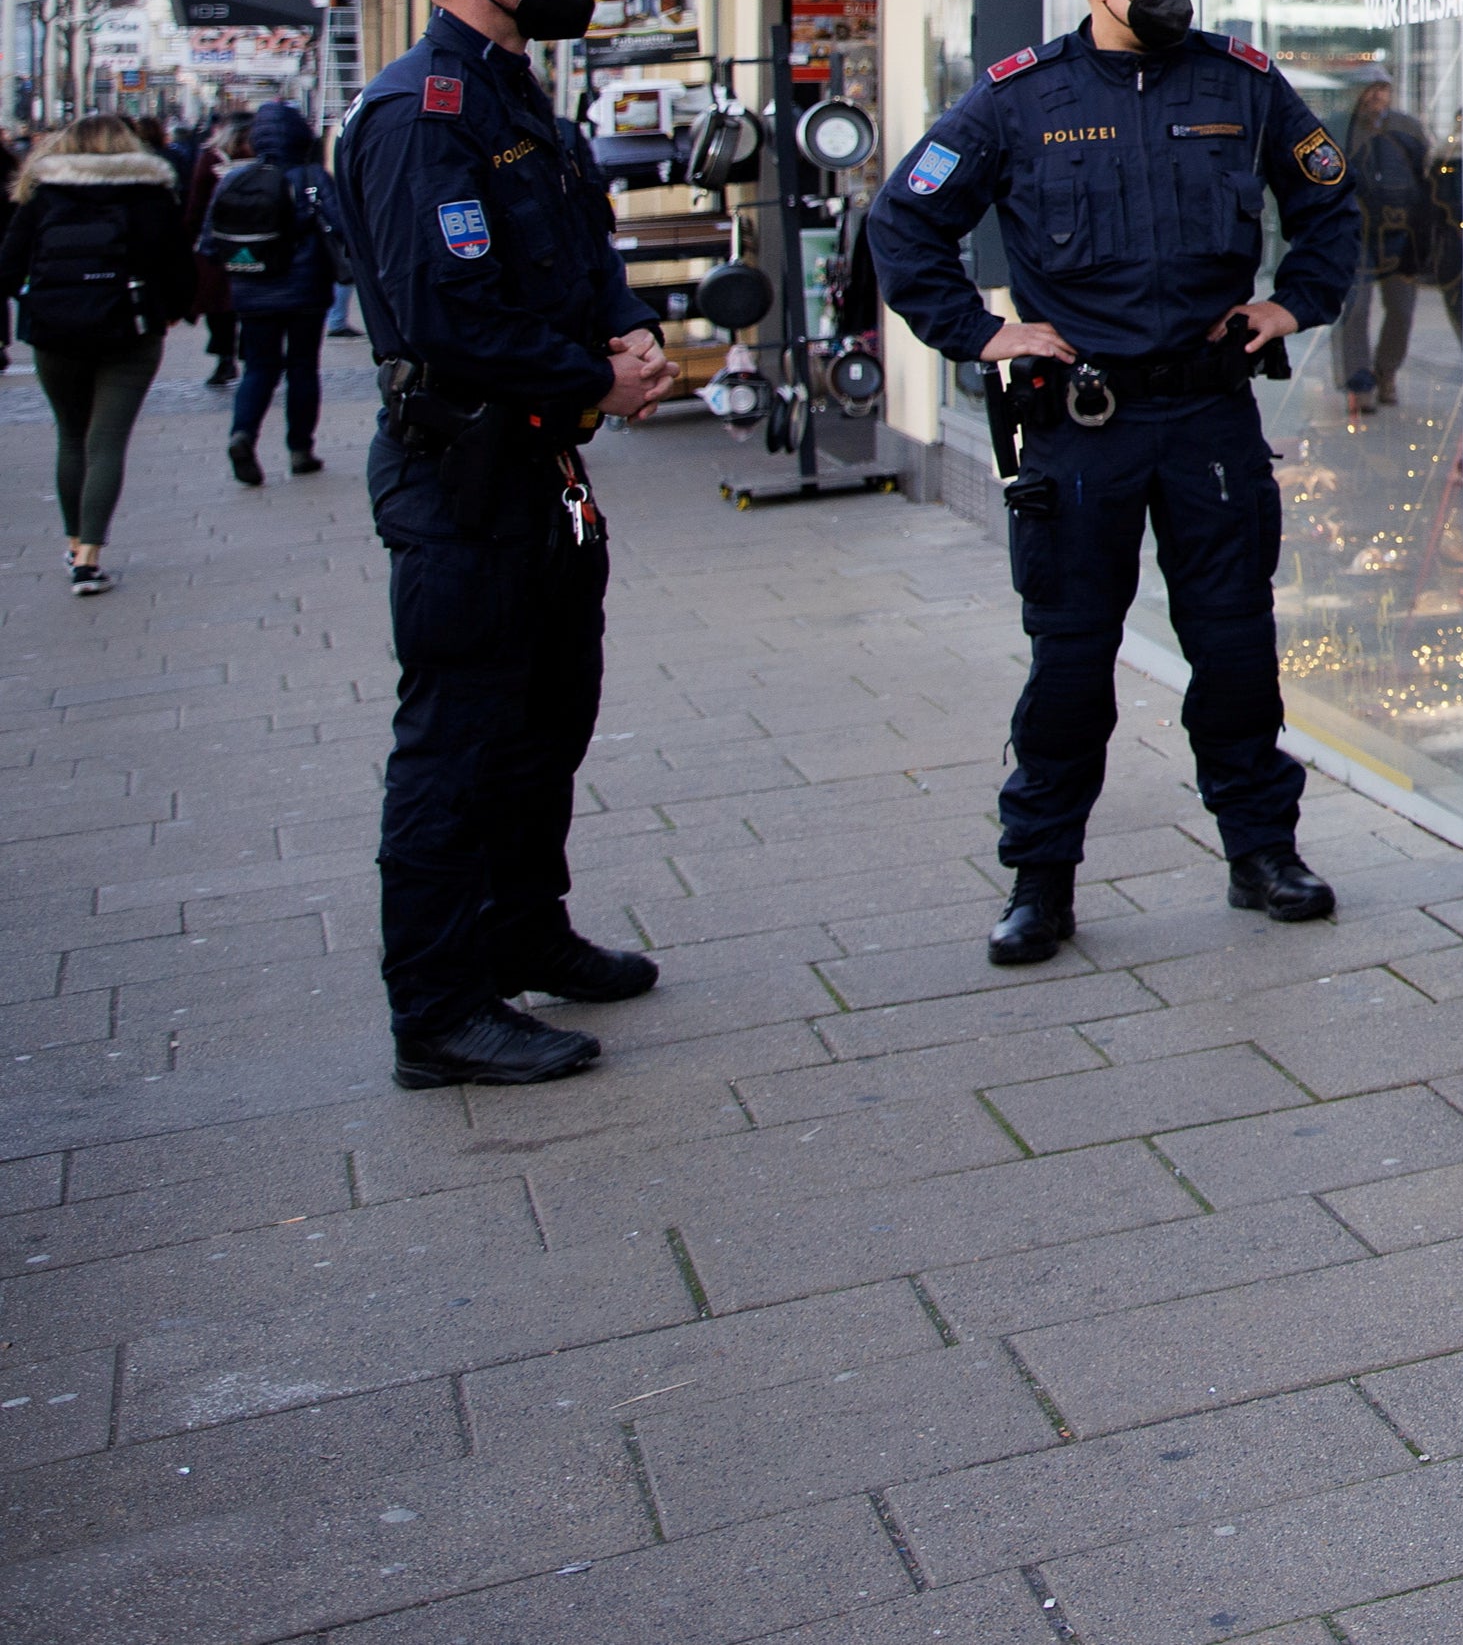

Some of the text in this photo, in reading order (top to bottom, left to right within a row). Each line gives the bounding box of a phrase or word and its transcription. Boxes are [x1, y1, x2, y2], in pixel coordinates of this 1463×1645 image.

[1043, 127, 1116, 144] POLIZEI
[917, 151, 951, 177] BE
[444, 209, 484, 236] BE
